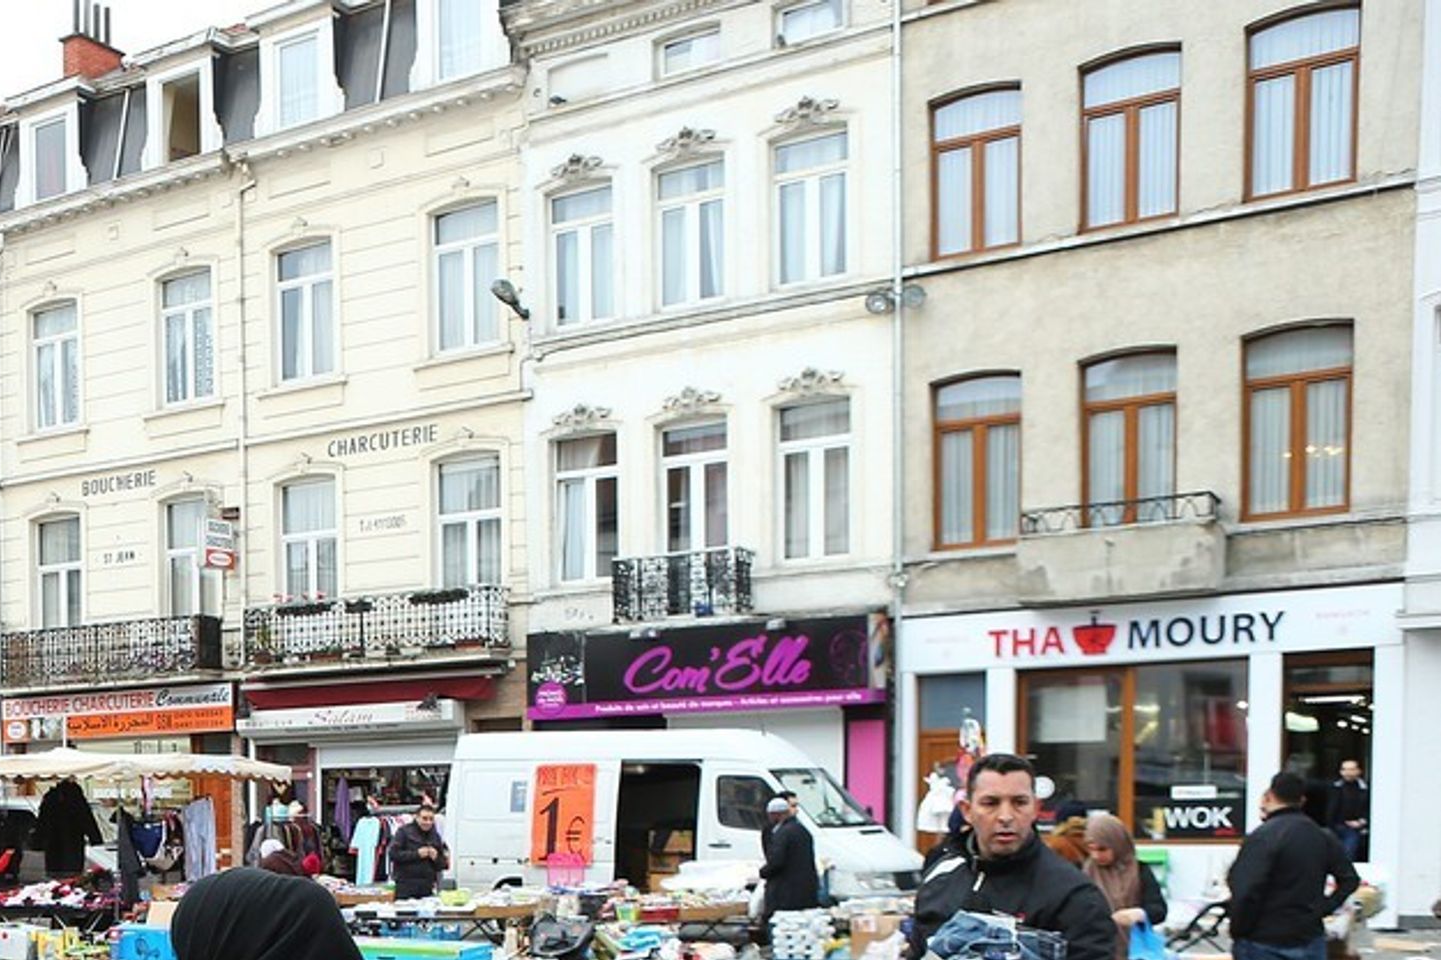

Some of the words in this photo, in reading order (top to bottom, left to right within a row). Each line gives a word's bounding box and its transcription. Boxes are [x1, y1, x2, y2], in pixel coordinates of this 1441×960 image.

[327, 424, 438, 457] CHARCUTERIE
[82, 470, 156, 496] BOUCHERIE
[1128, 610, 1286, 650] MOURY
[624, 636, 812, 693] Com'Elle
[5, 698, 70, 717] BOUCHERIE
[72, 691, 155, 712] CHARCUTERIE
[1163, 805, 1233, 829] WOK
